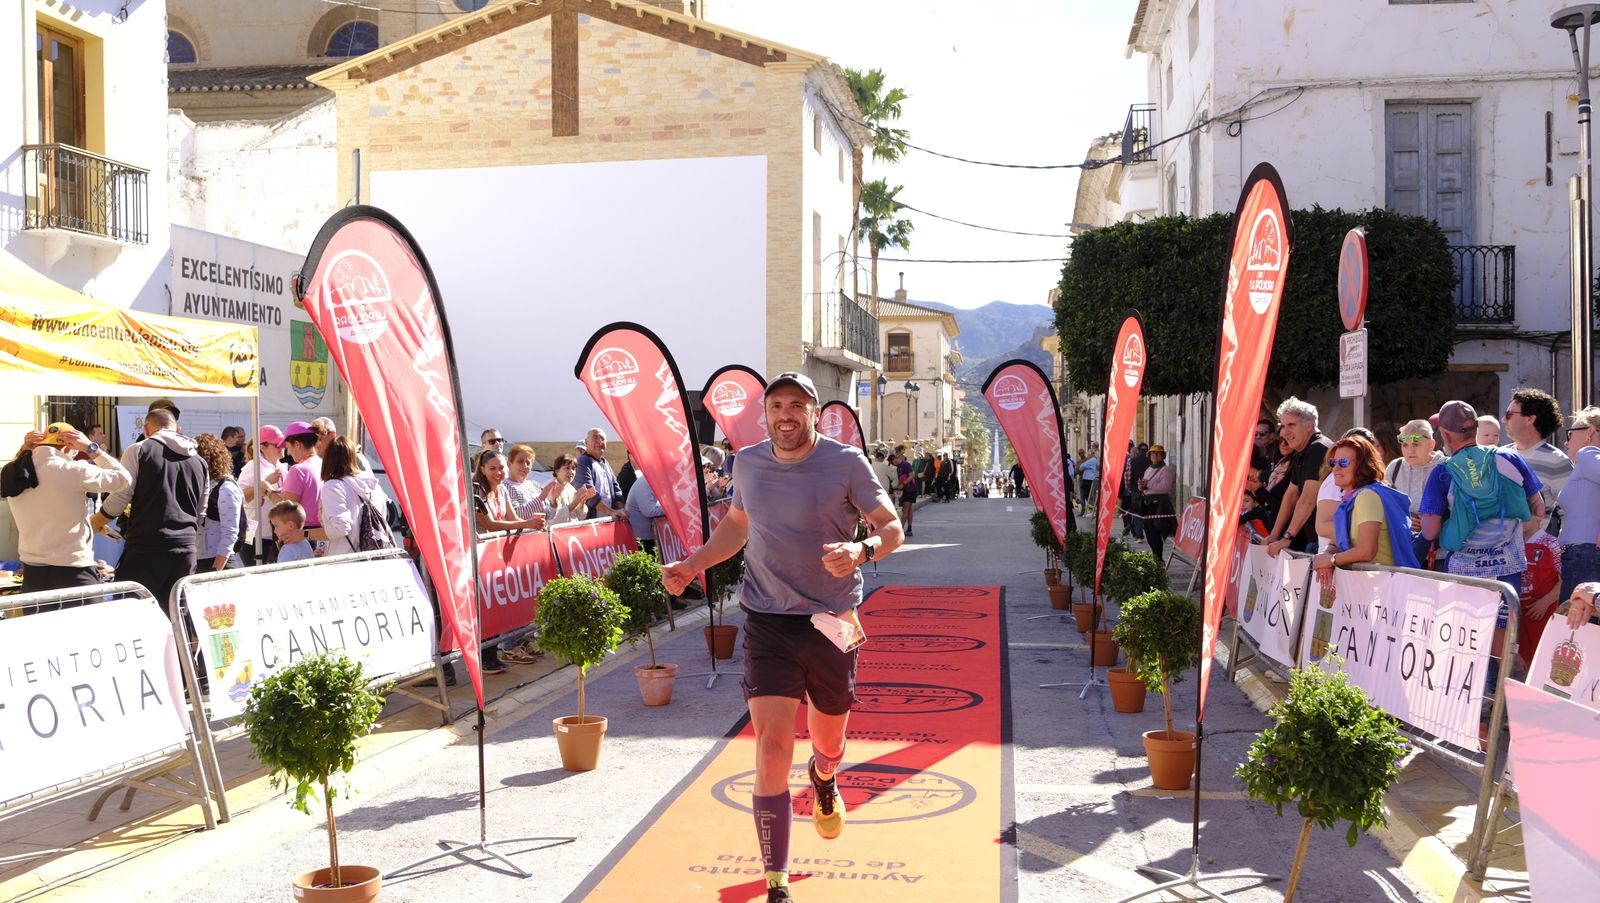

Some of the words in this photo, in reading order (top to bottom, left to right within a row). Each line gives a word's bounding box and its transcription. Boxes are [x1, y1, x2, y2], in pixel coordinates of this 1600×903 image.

[181, 257, 284, 296] EXCELENTÍSIMO
[184, 292, 282, 327] AYUNTAMIENTO
[1475, 558, 1507, 568] SALAS
[478, 562, 544, 609] VEOLIA
[257, 588, 388, 625] AYUNTAMIENTO
[395, 584, 416, 601] DE
[115, 638, 145, 663] DE
[261, 605, 425, 669] CANTORIA
[1458, 626, 1478, 651] DE
[756, 810, 777, 866] kalenji
[716, 854, 856, 869] Canria
[866, 861, 906, 871] de
